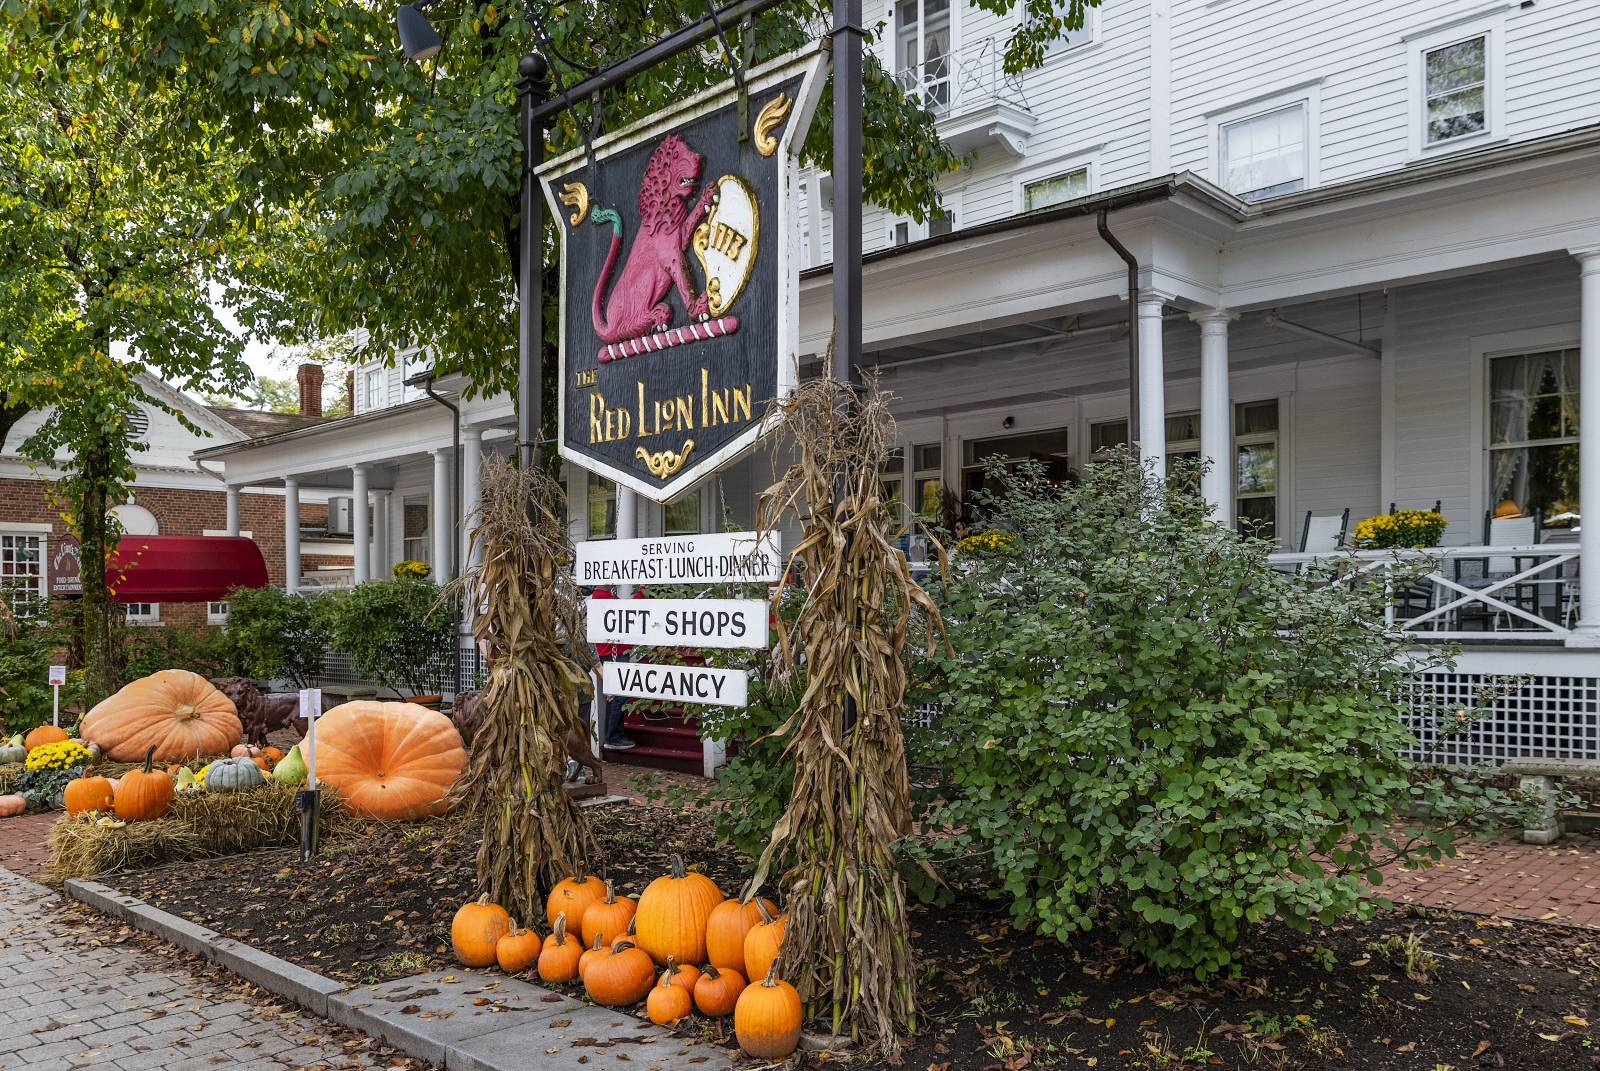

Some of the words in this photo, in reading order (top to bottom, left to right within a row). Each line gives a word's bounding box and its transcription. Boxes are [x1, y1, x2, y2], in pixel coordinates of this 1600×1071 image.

[711, 221, 745, 259] 1773
[575, 368, 598, 387] THE
[589, 392, 631, 444] RED
[637, 380, 693, 437] LION
[701, 367, 752, 428] INN
[641, 541, 695, 556] SERVING
[584, 558, 664, 580] BREAKFAST
[669, 556, 713, 578] LUNCH
[603, 609, 650, 635] GIFT
[665, 610, 747, 637] SHOPS
[617, 667, 727, 699] VACANCY
